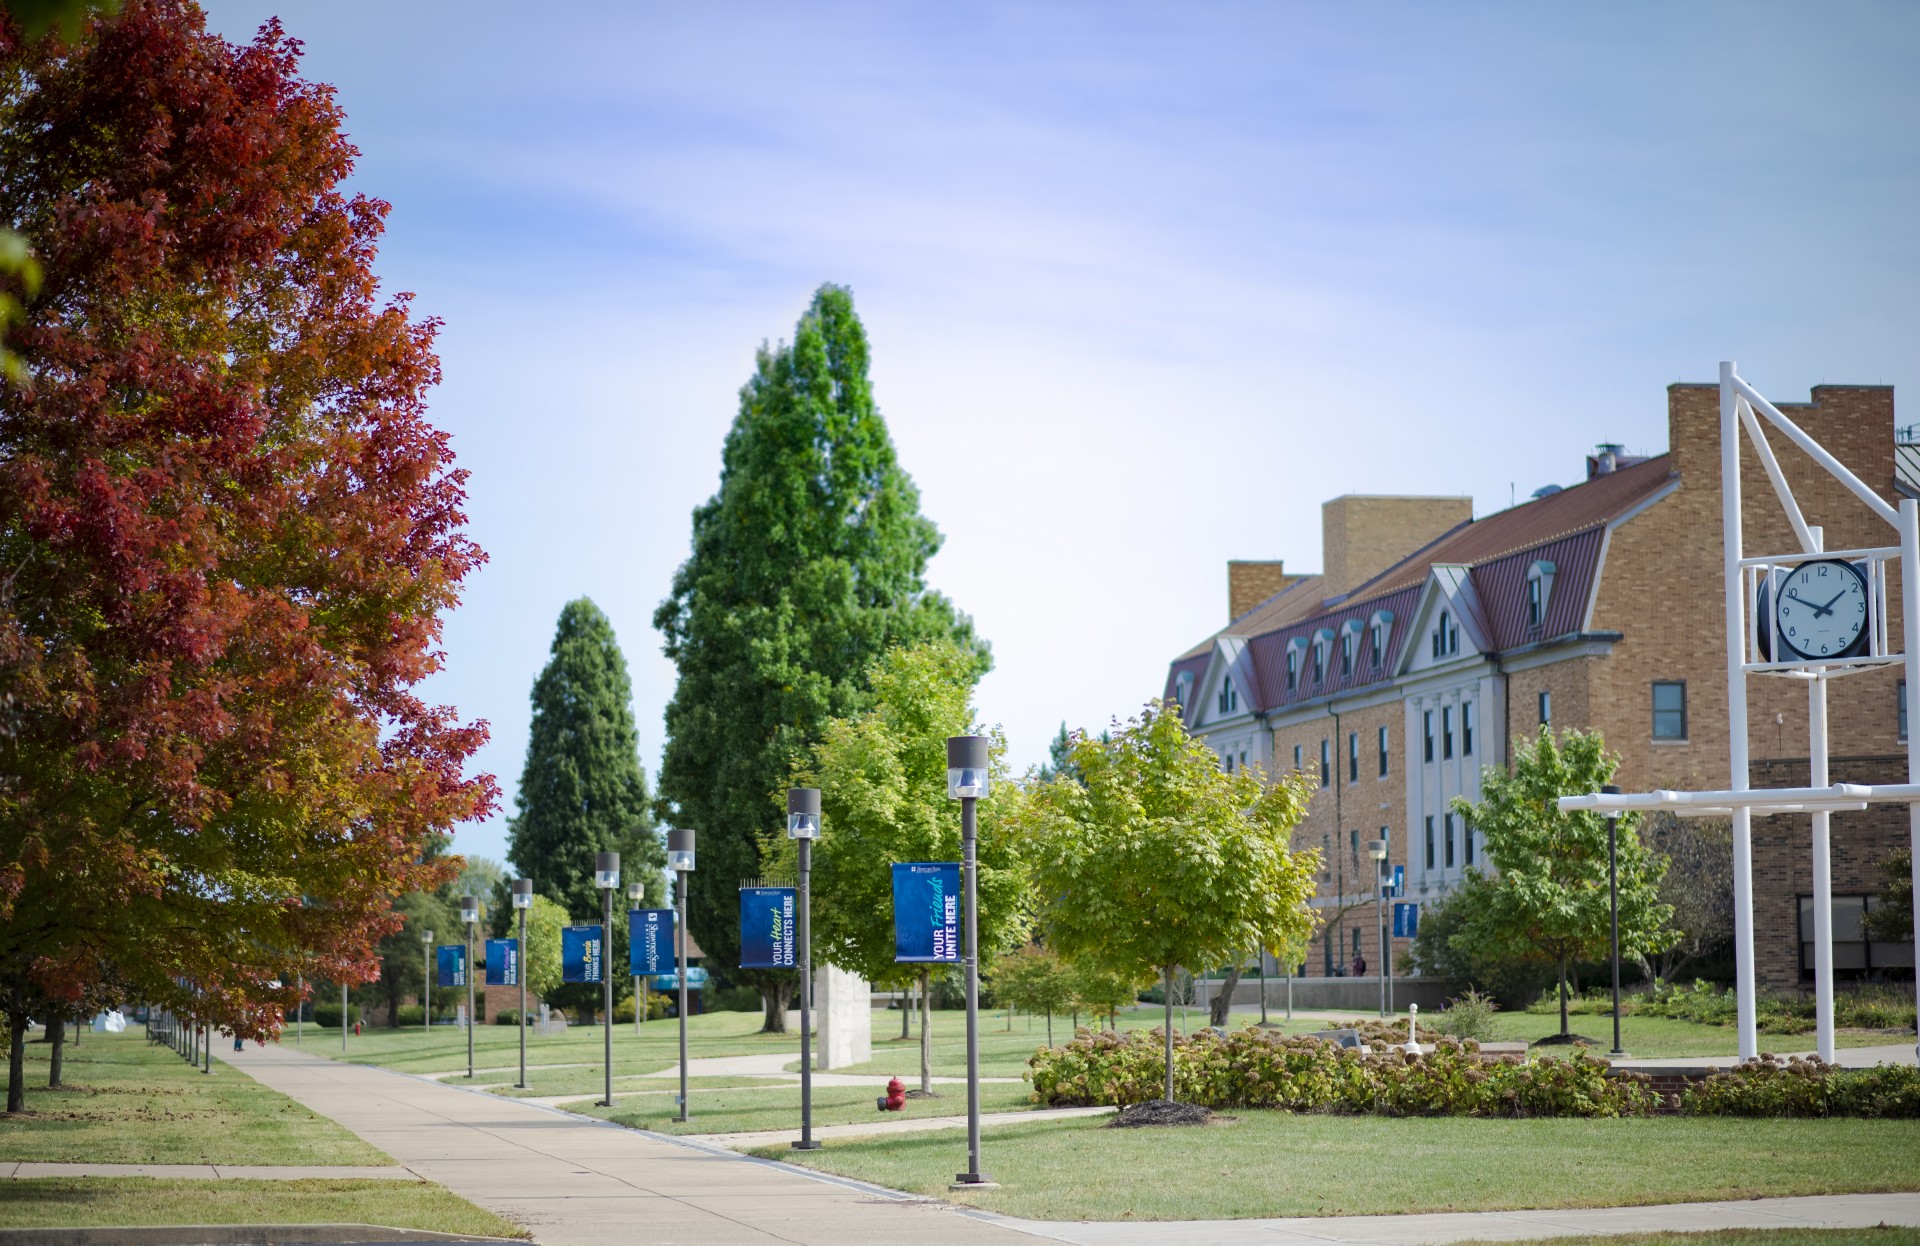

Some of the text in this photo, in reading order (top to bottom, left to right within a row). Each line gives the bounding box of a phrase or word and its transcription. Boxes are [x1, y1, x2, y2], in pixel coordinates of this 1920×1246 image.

[1818, 566, 1828, 577] 12
[1801, 573, 1808, 584] 11
[1851, 582, 1858, 593] 2
[1788, 588, 1798, 599] 10
[1783, 607, 1790, 617] 9
[1858, 602, 1865, 613] 3
[1788, 626, 1796, 636] 8
[1851, 622, 1859, 633] 4
[1804, 638, 1810, 649] 7
[1838, 638, 1846, 648] 5
[1821, 644, 1828, 654] 6
[927, 876, 944, 927] Friends
[770, 907, 782, 941] Heart
[945, 895, 956, 959] UNITE HERE
[784, 896, 793, 966] CONNECTS HERE
[650, 924, 659, 972] Shawnee State
[934, 930, 944, 960] YOUR
[582, 940, 592, 963] Brain
[773, 942, 782, 966] YOUR
